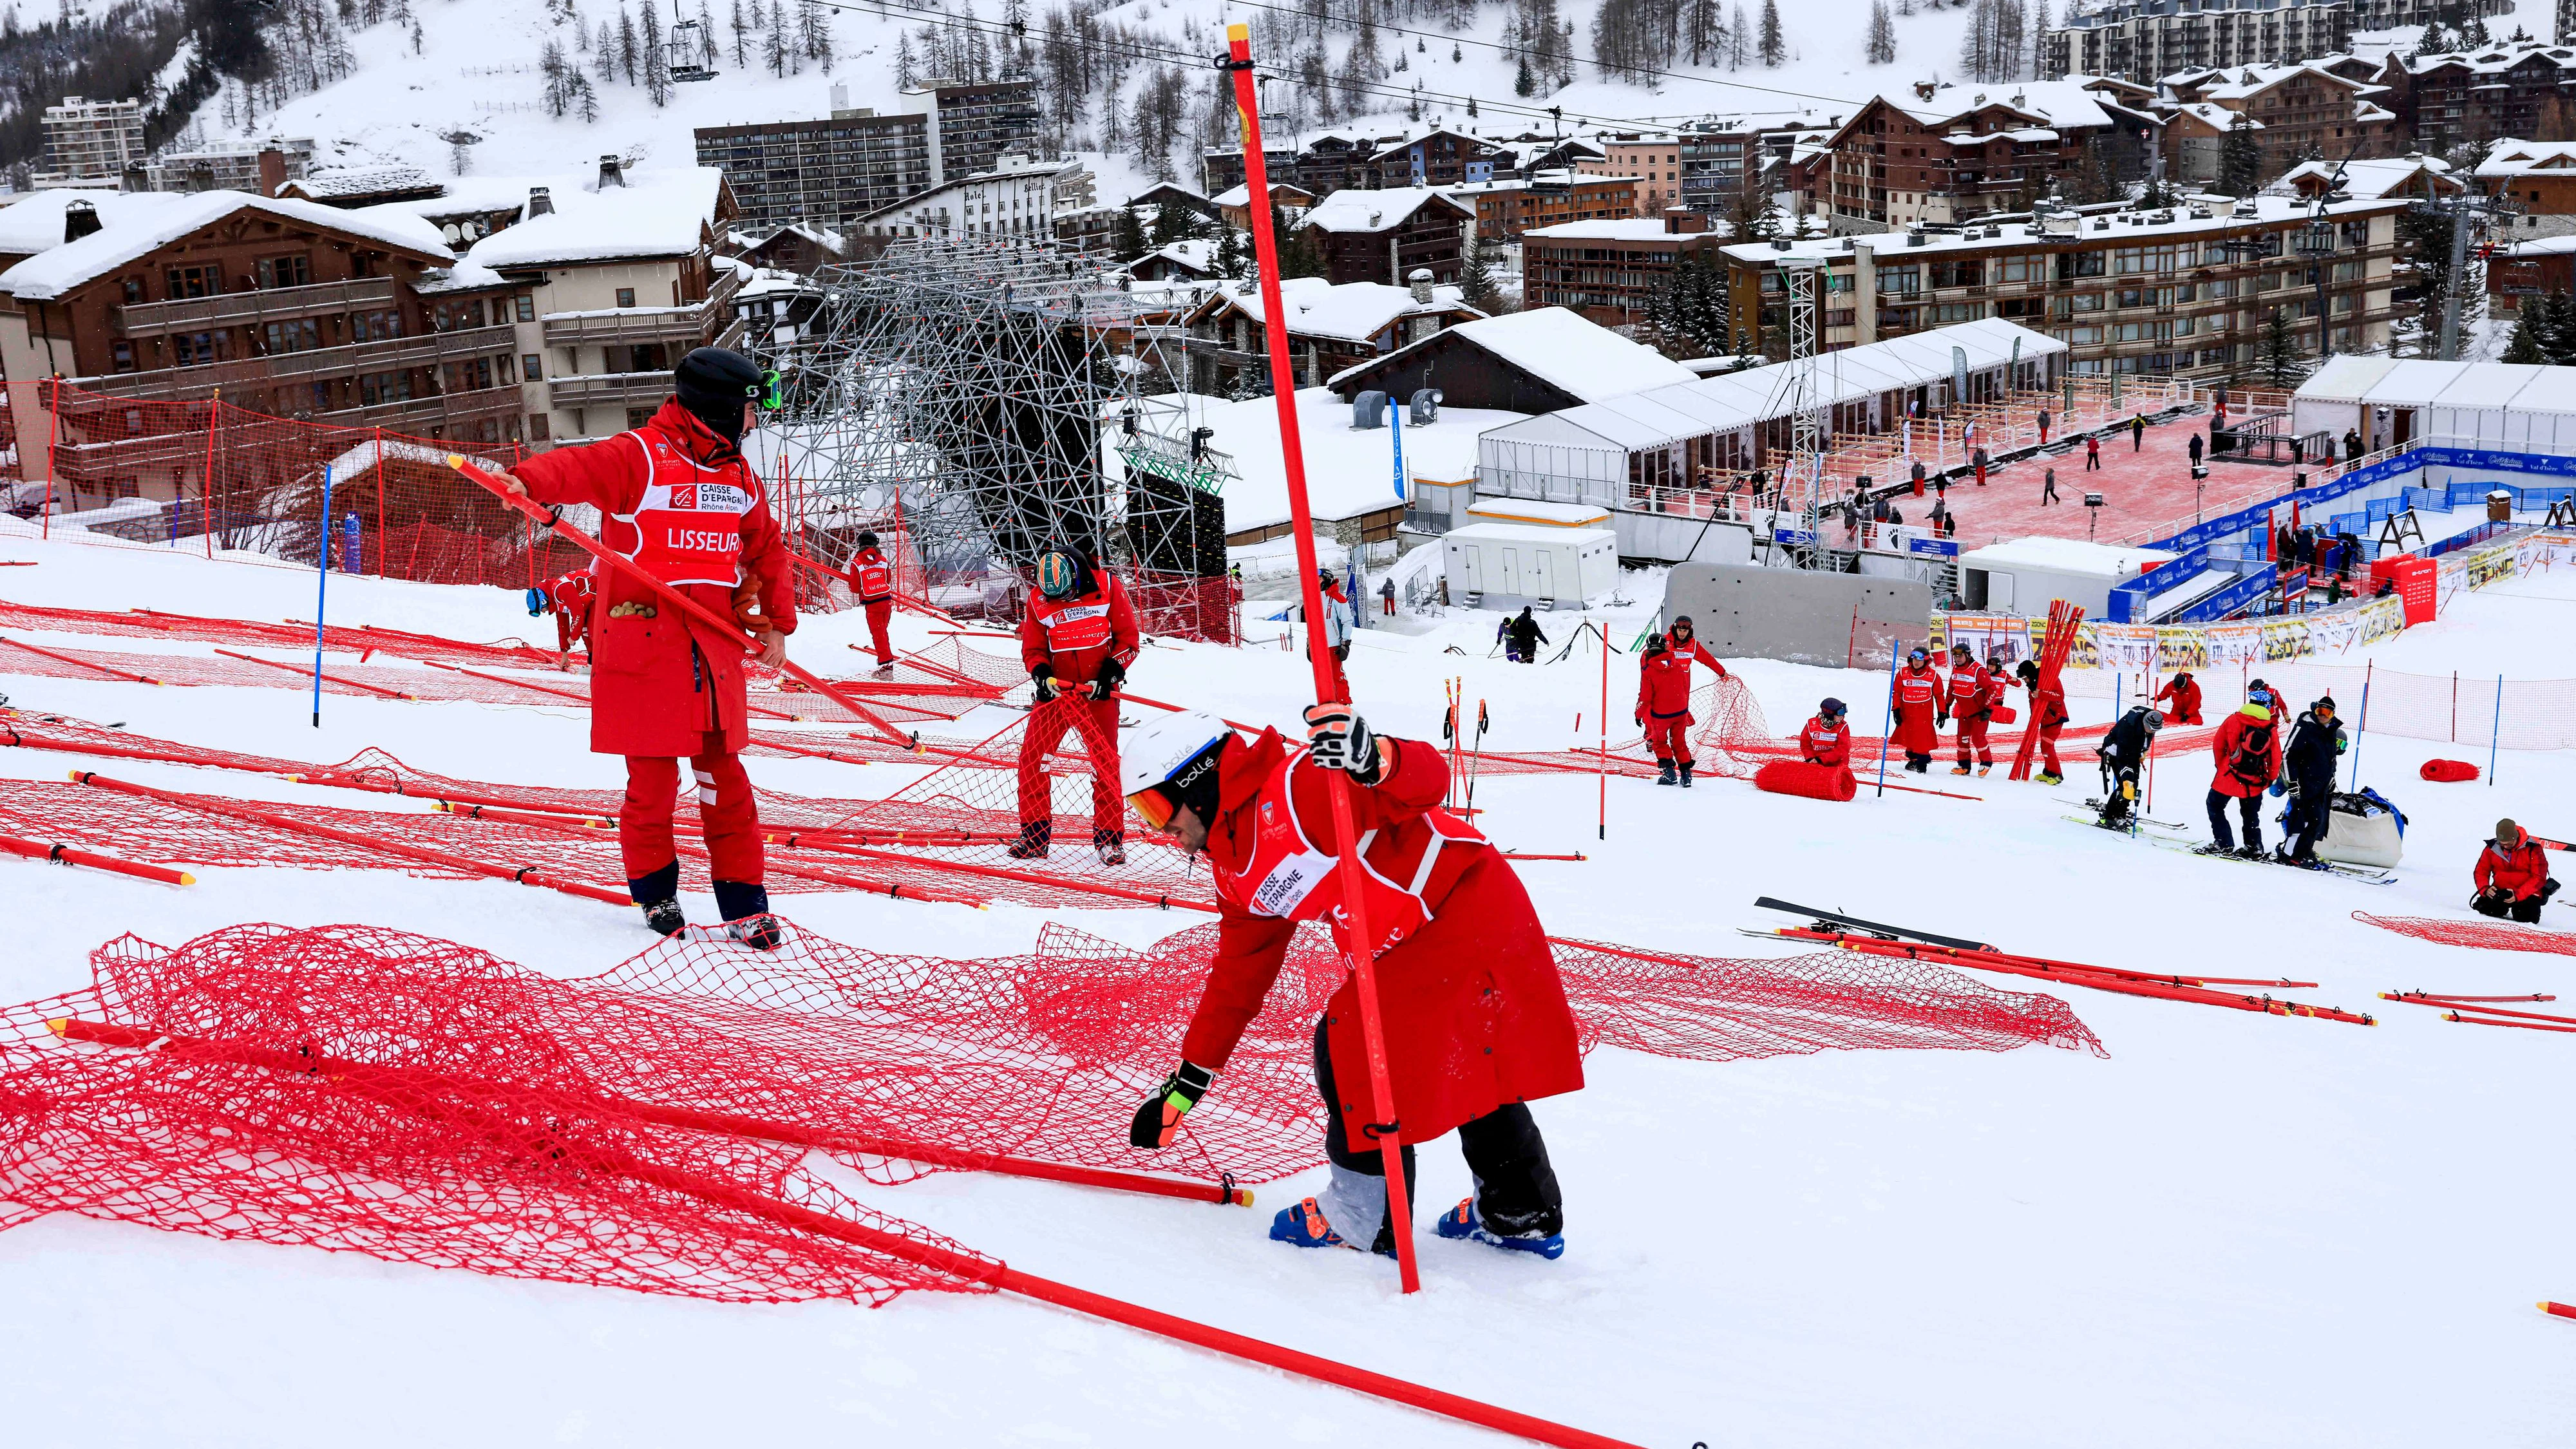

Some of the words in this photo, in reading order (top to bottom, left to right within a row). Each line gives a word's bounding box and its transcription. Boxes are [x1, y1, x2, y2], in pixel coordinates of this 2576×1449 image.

[701, 485, 731, 494] CAISSE
[724, 504, 739, 512] Alpes
[1161, 744, 1193, 771] bollé
[1176, 756, 1215, 788] bollé
[1257, 873, 1280, 901] CAISSE
[1266, 869, 1303, 911] D'EPARGNE
[1288, 889, 1303, 904] Alpes
